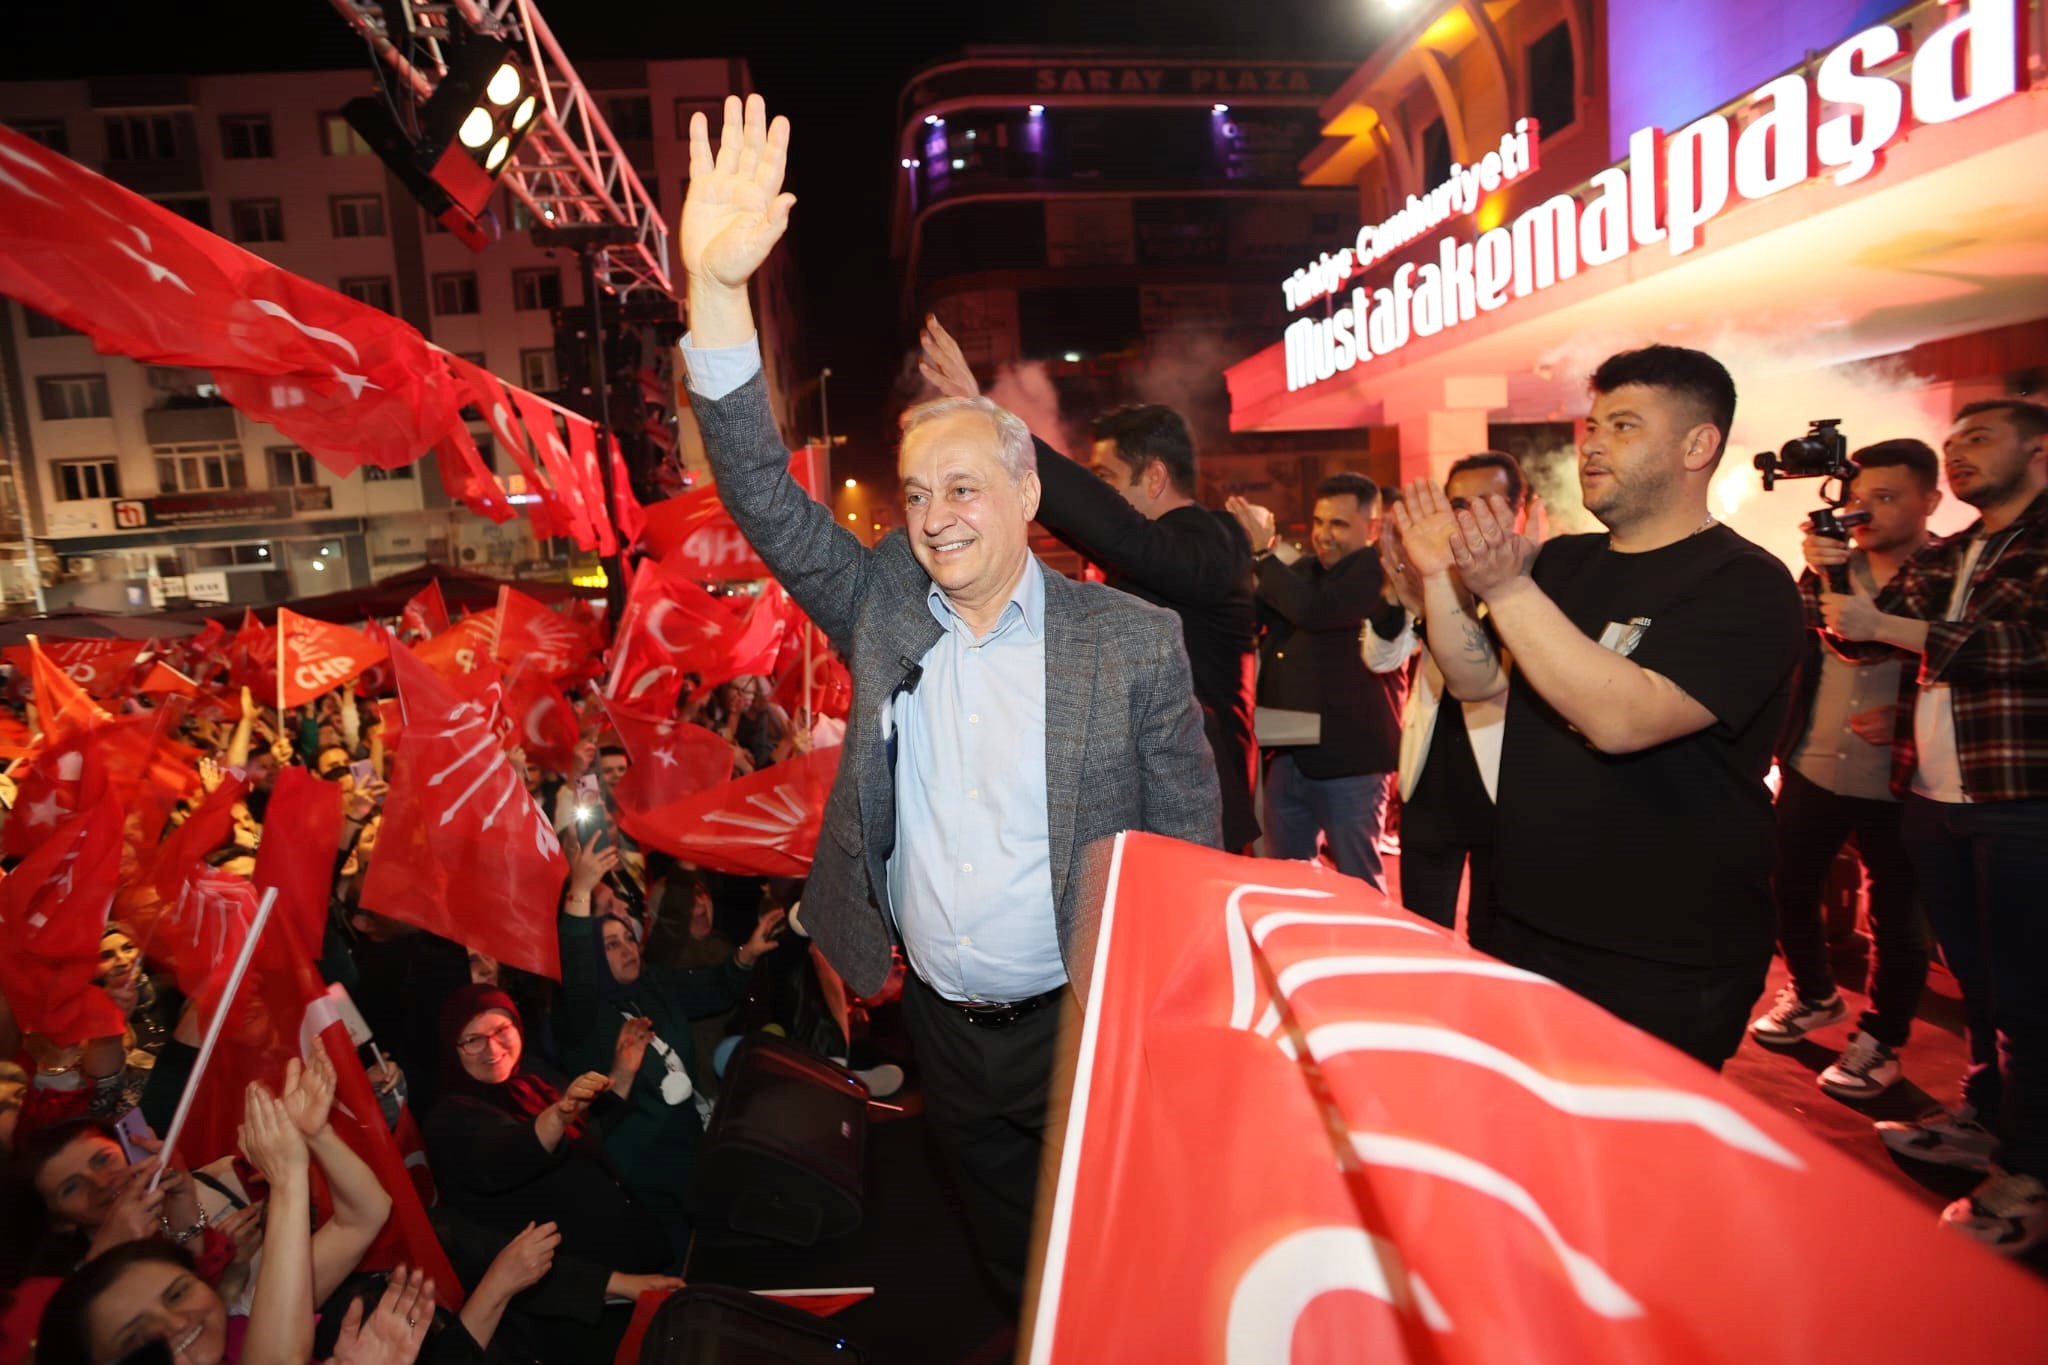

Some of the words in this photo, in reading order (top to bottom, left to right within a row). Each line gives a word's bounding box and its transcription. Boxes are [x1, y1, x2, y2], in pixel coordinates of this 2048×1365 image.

[1036, 69, 1165, 91] SARAY
[1190, 69, 1311, 91] PLAZA
[1282, 252, 1353, 312] Türkiye
[1356, 117, 1530, 267] Cumhuriyeti
[1284, 0, 2017, 393] Mustafakemalpaşa
[295, 656, 355, 690] CHP
